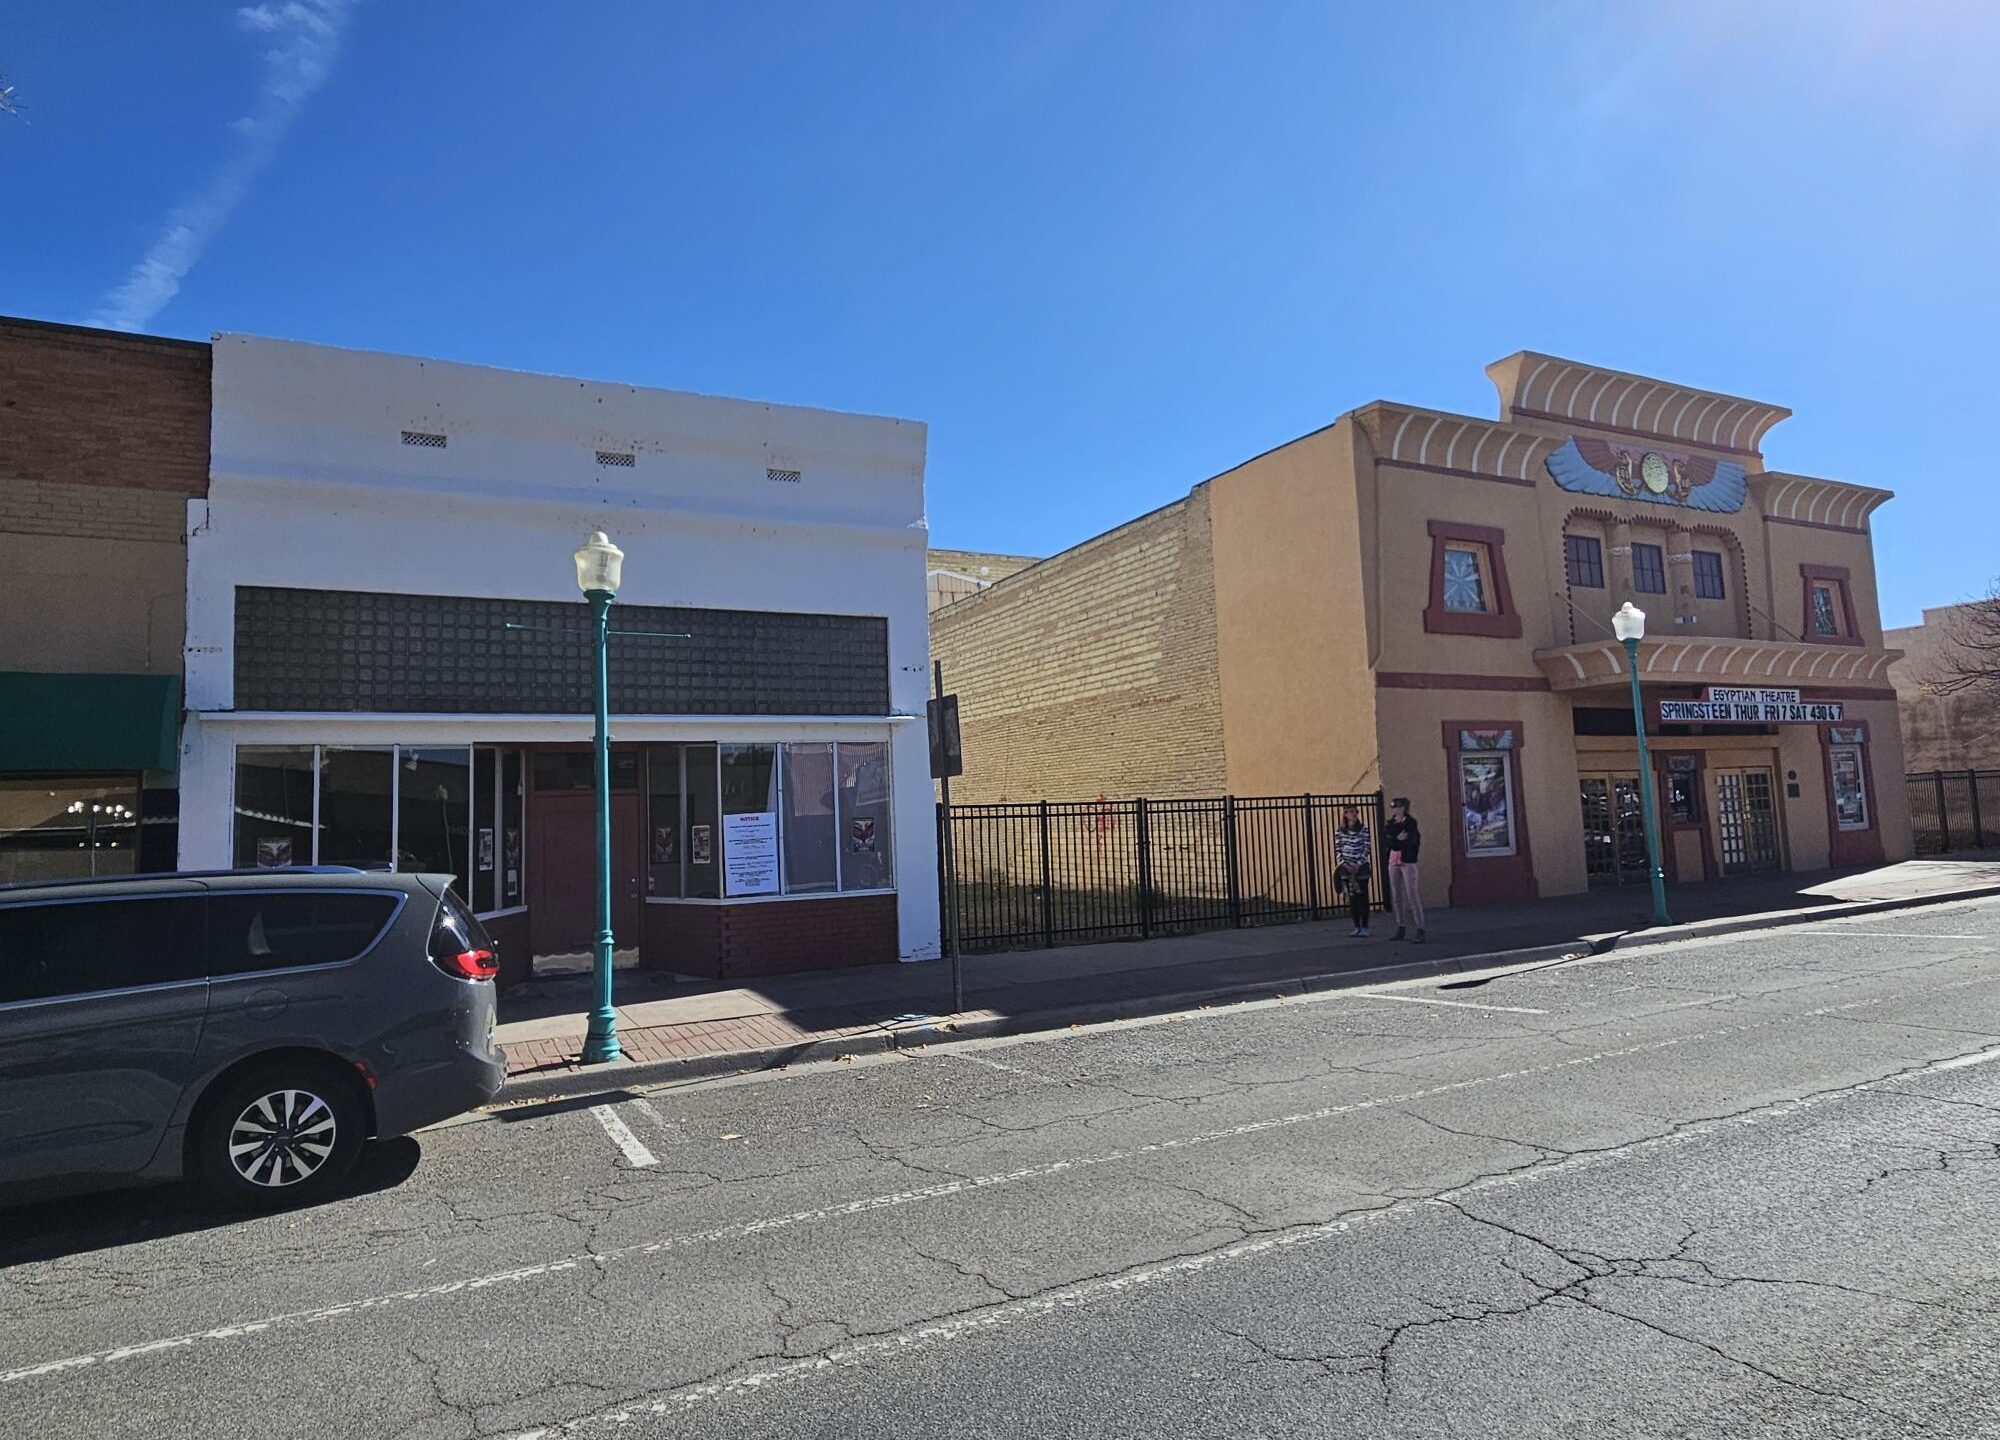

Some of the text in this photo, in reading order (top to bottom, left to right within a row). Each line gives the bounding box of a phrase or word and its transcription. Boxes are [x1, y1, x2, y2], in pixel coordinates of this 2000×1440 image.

[1713, 689, 1796, 703] EGYPTIAN THEATRE
[1662, 702, 1731, 720] SPRINGSTEEN
[1734, 703, 1760, 721] THUR
[1765, 704, 1780, 721] FRI
[1781, 705, 1787, 721] 7
[1790, 704, 1807, 721] SAT
